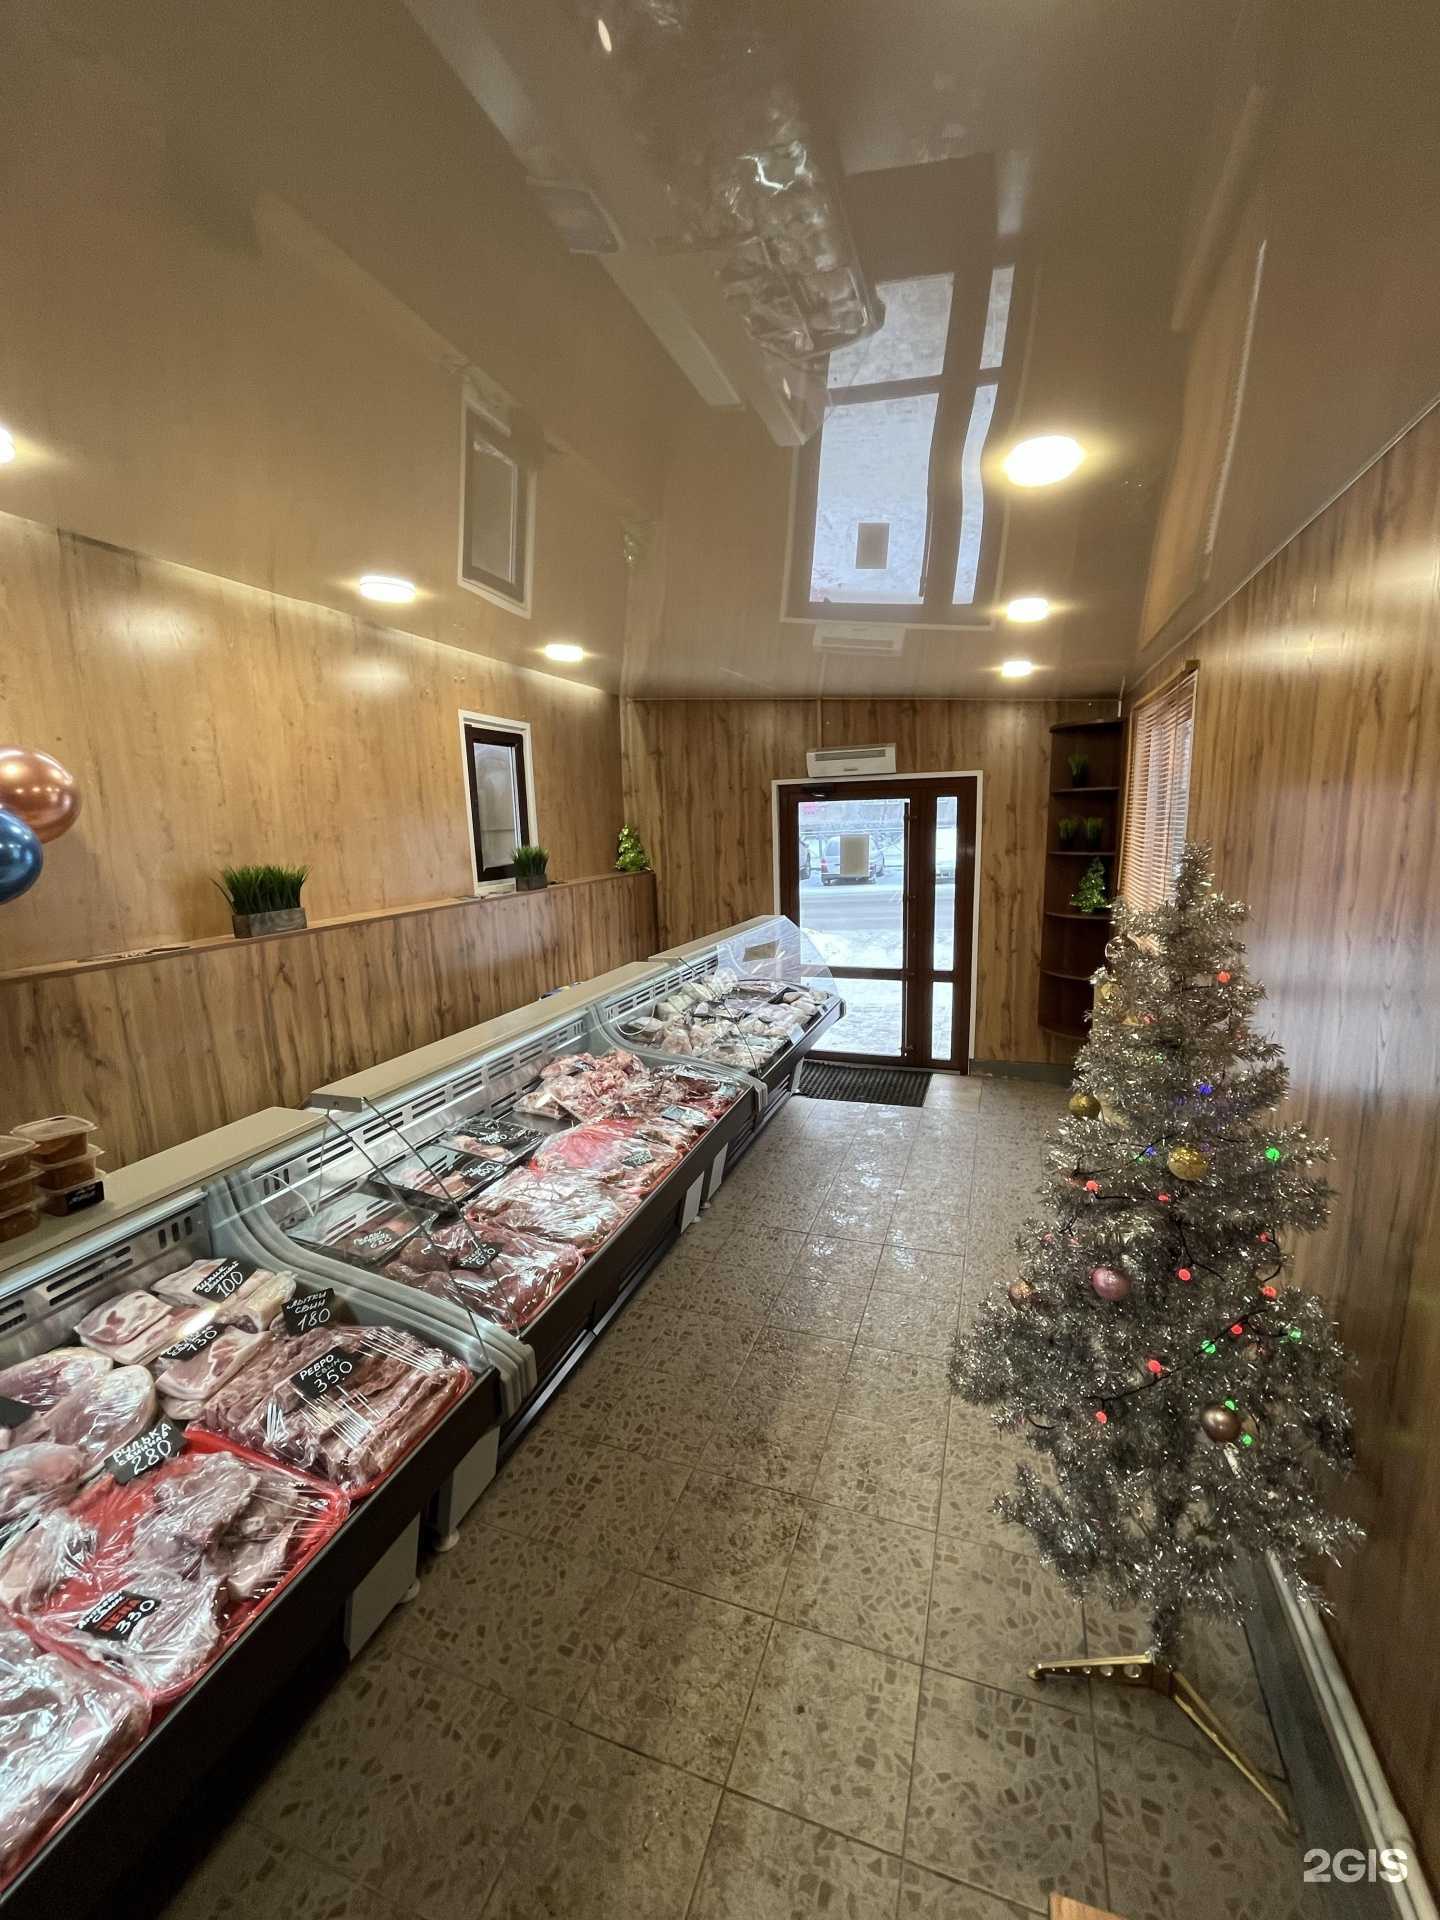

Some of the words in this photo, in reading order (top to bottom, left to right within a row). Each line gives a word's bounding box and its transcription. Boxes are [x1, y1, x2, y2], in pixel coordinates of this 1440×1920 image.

[216, 1271, 243, 1297] 100
[297, 1308, 331, 1331] 180
[187, 1330, 218, 1351] 130
[300, 1354, 334, 1381] РЕБРО
[313, 1361, 353, 1393] 350
[131, 1440, 171, 1475] 280
[115, 1599, 155, 1635] 330
